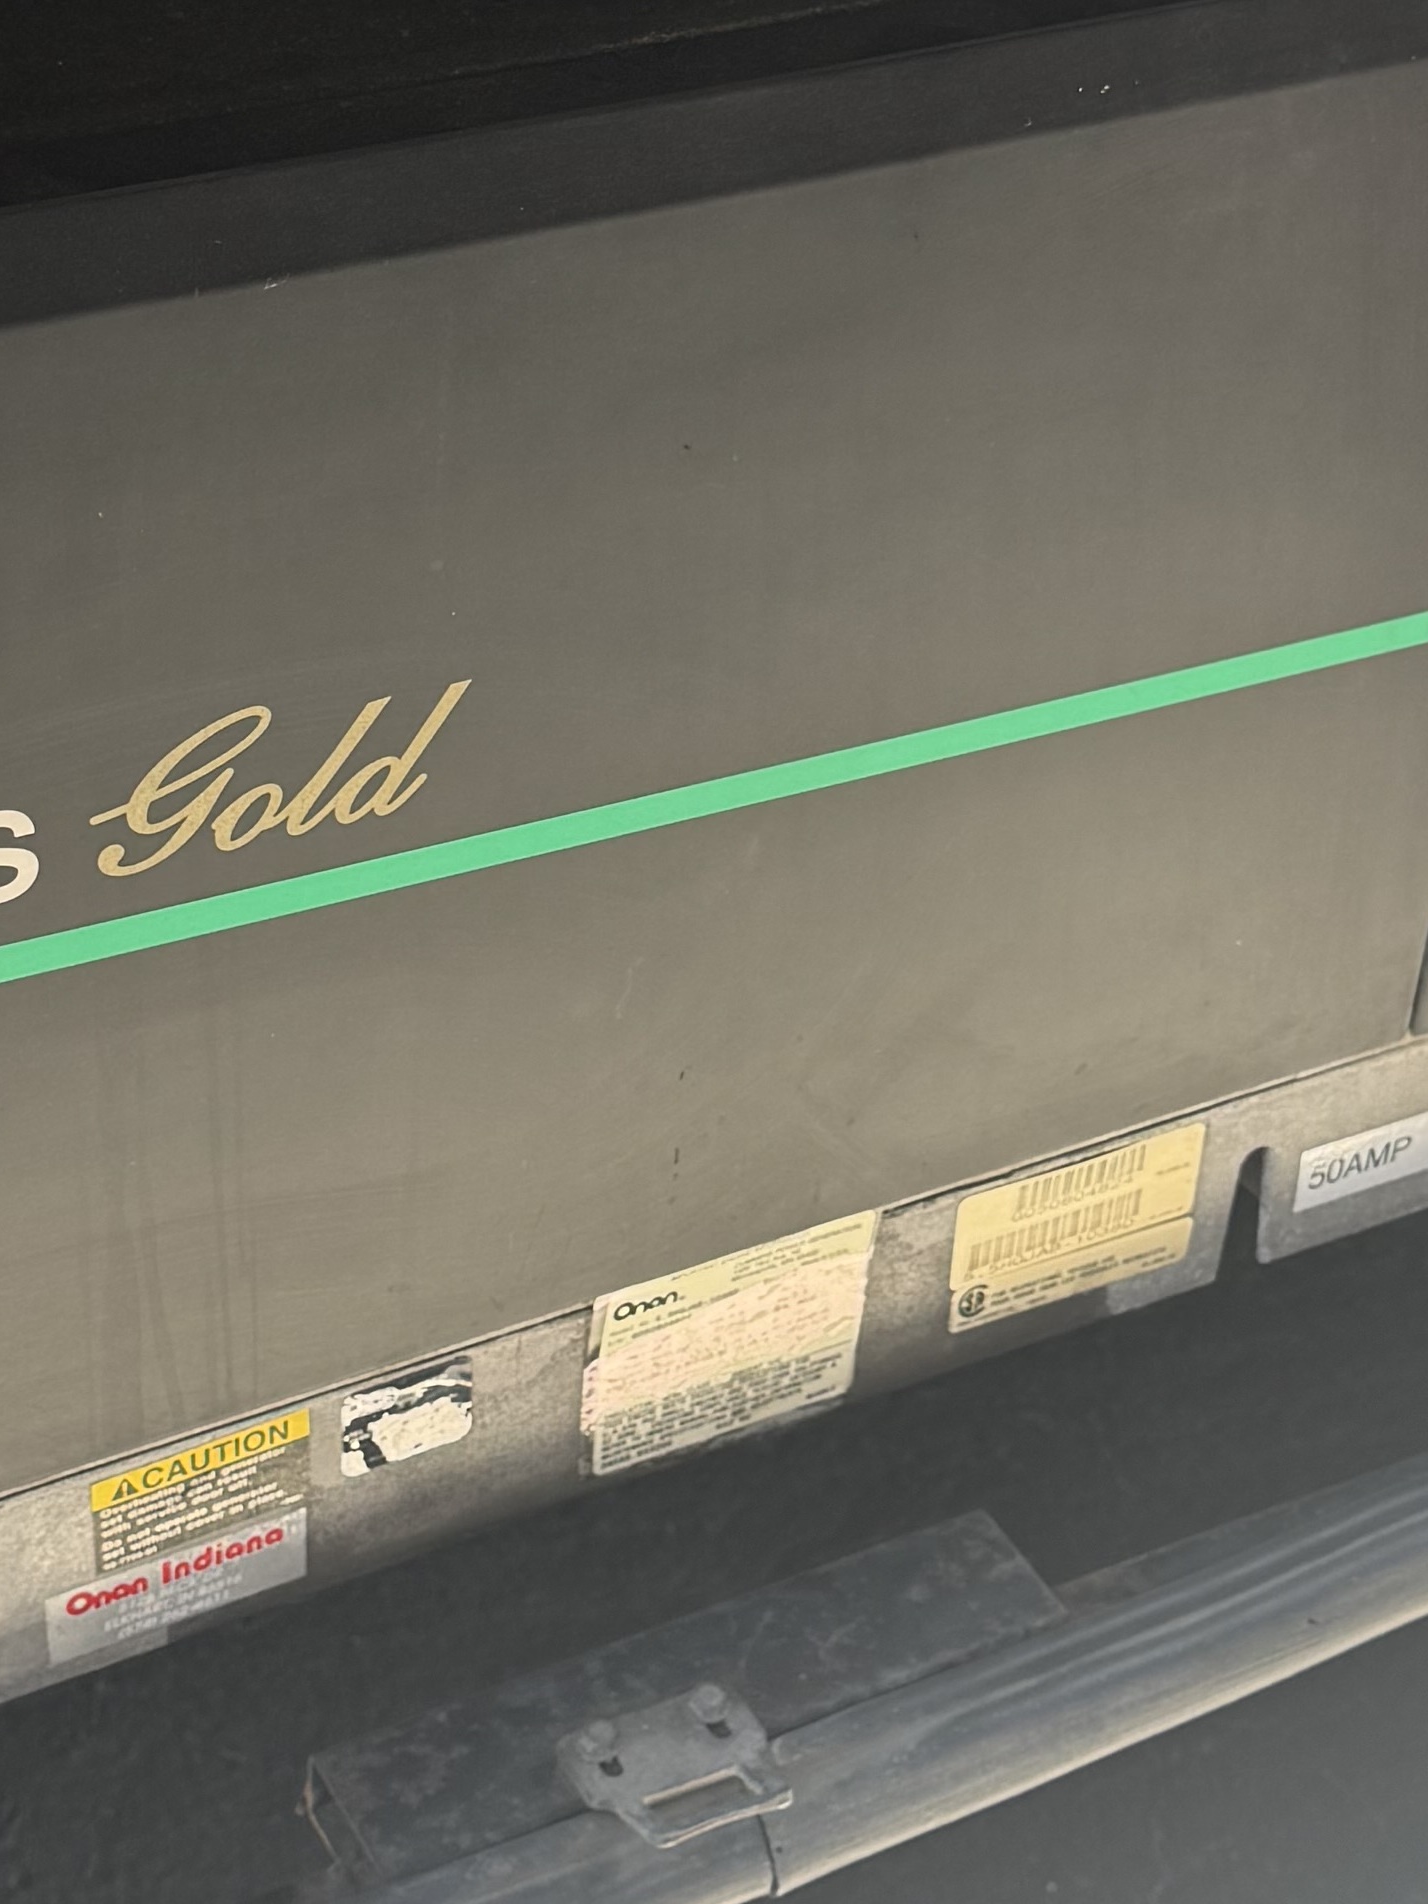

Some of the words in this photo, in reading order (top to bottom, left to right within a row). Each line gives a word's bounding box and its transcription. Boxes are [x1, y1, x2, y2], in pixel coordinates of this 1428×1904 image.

[89, 679, 472, 879] Gold
[1308, 1135, 1414, 1190] 50AMP
[613, 1291, 678, 1321] Onan
[140, 1418, 290, 1490] CAUTION
[66, 1574, 149, 1616] Onan
[162, 1527, 284, 1585] Indiana
